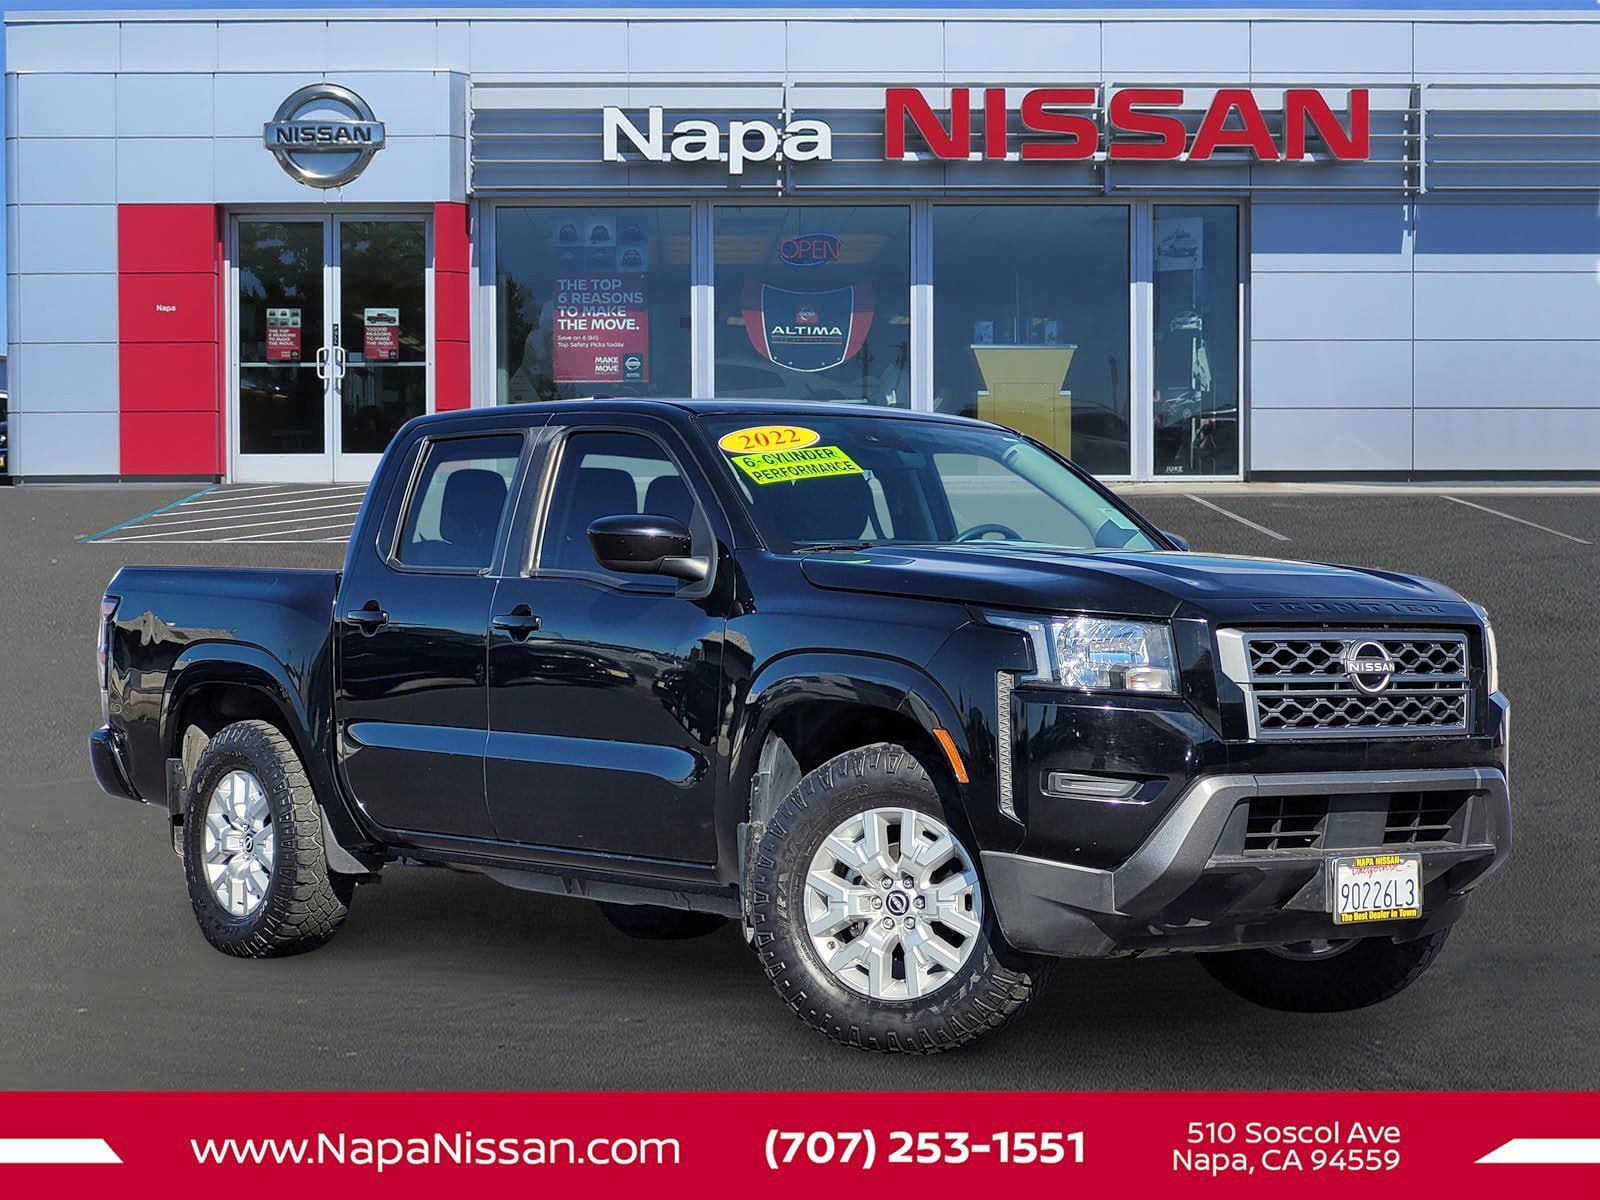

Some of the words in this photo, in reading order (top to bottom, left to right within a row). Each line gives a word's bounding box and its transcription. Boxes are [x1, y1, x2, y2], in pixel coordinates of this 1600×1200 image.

[276, 126, 372, 143] NISSAN
[603, 106, 833, 174] Napa
[885, 88, 1371, 161] NISSAN
[781, 240, 840, 260] OPEN
[557, 279, 587, 291] THE
[591, 279, 622, 291] TOP
[558, 292, 568, 304] 6
[571, 292, 644, 304] REASONS
[156, 304, 177, 312] Napa
[558, 305, 578, 317] TO
[582, 305, 626, 317] MAKE
[558, 319, 587, 330] THE
[591, 319, 640, 330] MOVE.
[771, 326, 842, 335] ALTIMA
[738, 429, 801, 449] 2022
[751, 460, 857, 481] PERFORMANCE
[1252, 602, 1446, 614] FRONTIER
[1349, 661, 1395, 673] NISSAN
[1356, 858, 1374, 867] NAPA
[1375, 855, 1400, 866] NISSAN
[1341, 879, 1415, 912] 90226L3
[1341, 913, 1353, 922] The
[1353, 911, 1368, 921] Best
[1369, 909, 1390, 920] Dealer
[1391, 908, 1398, 917] in
[1400, 908, 1417, 917] Town
